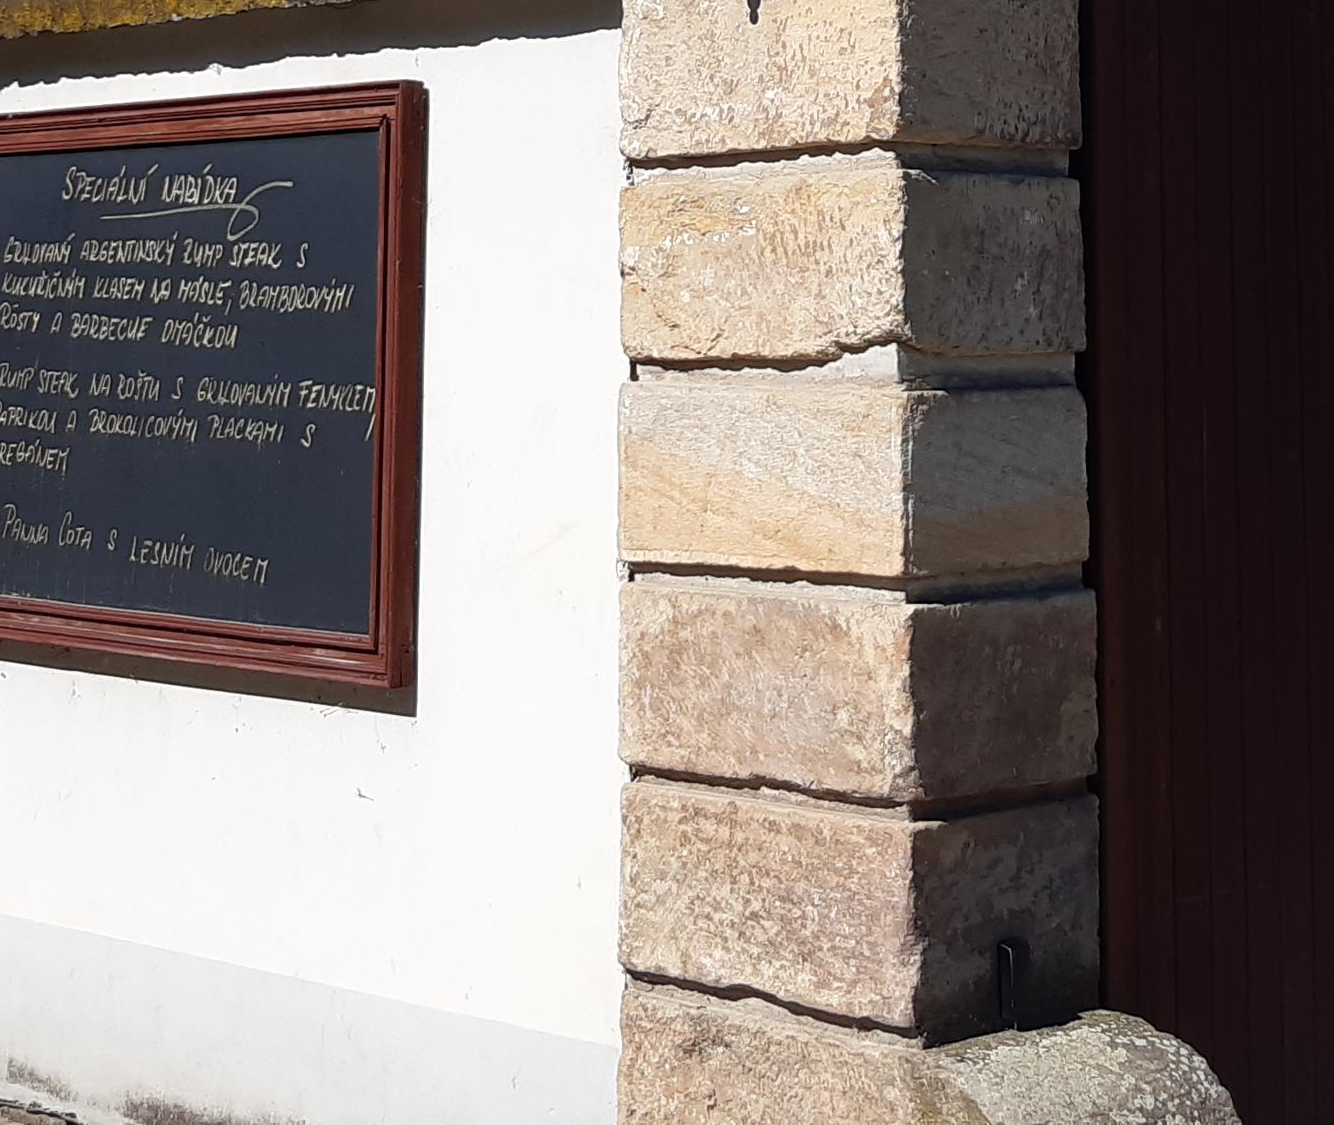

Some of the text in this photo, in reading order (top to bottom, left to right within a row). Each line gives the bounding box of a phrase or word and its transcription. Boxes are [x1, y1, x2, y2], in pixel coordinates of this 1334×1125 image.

[62, 164, 237, 204] SPECIÁLNÍ NABÍDKA
[80, 231, 178, 265] ARGENTINSKÝ
[183, 238, 223, 267] RUMP
[229, 241, 282, 269] STEAK
[296, 242, 309, 268] S
[93, 275, 144, 300] KLASEM
[150, 278, 171, 304] NA
[177, 276, 232, 315] MÁSLE,
[239, 279, 354, 313] BRAMBOROVÝMI
[50, 312, 63, 333] A
[70, 313, 153, 341] BARBECUE
[161, 312, 238, 348] OMÁČKOU
[38, 369, 79, 398] STEAK
[89, 374, 111, 395] NA
[117, 369, 159, 401] ROŠTU
[171, 377, 184, 400] S
[66, 410, 77, 432] A
[89, 409, 198, 443] BROKOLICOVÝMI
[208, 414, 284, 443] PLACKAMI
[301, 423, 315, 448] S
[2, 503, 269, 584] PANNA COTA S LESNÍM OVOCEM
